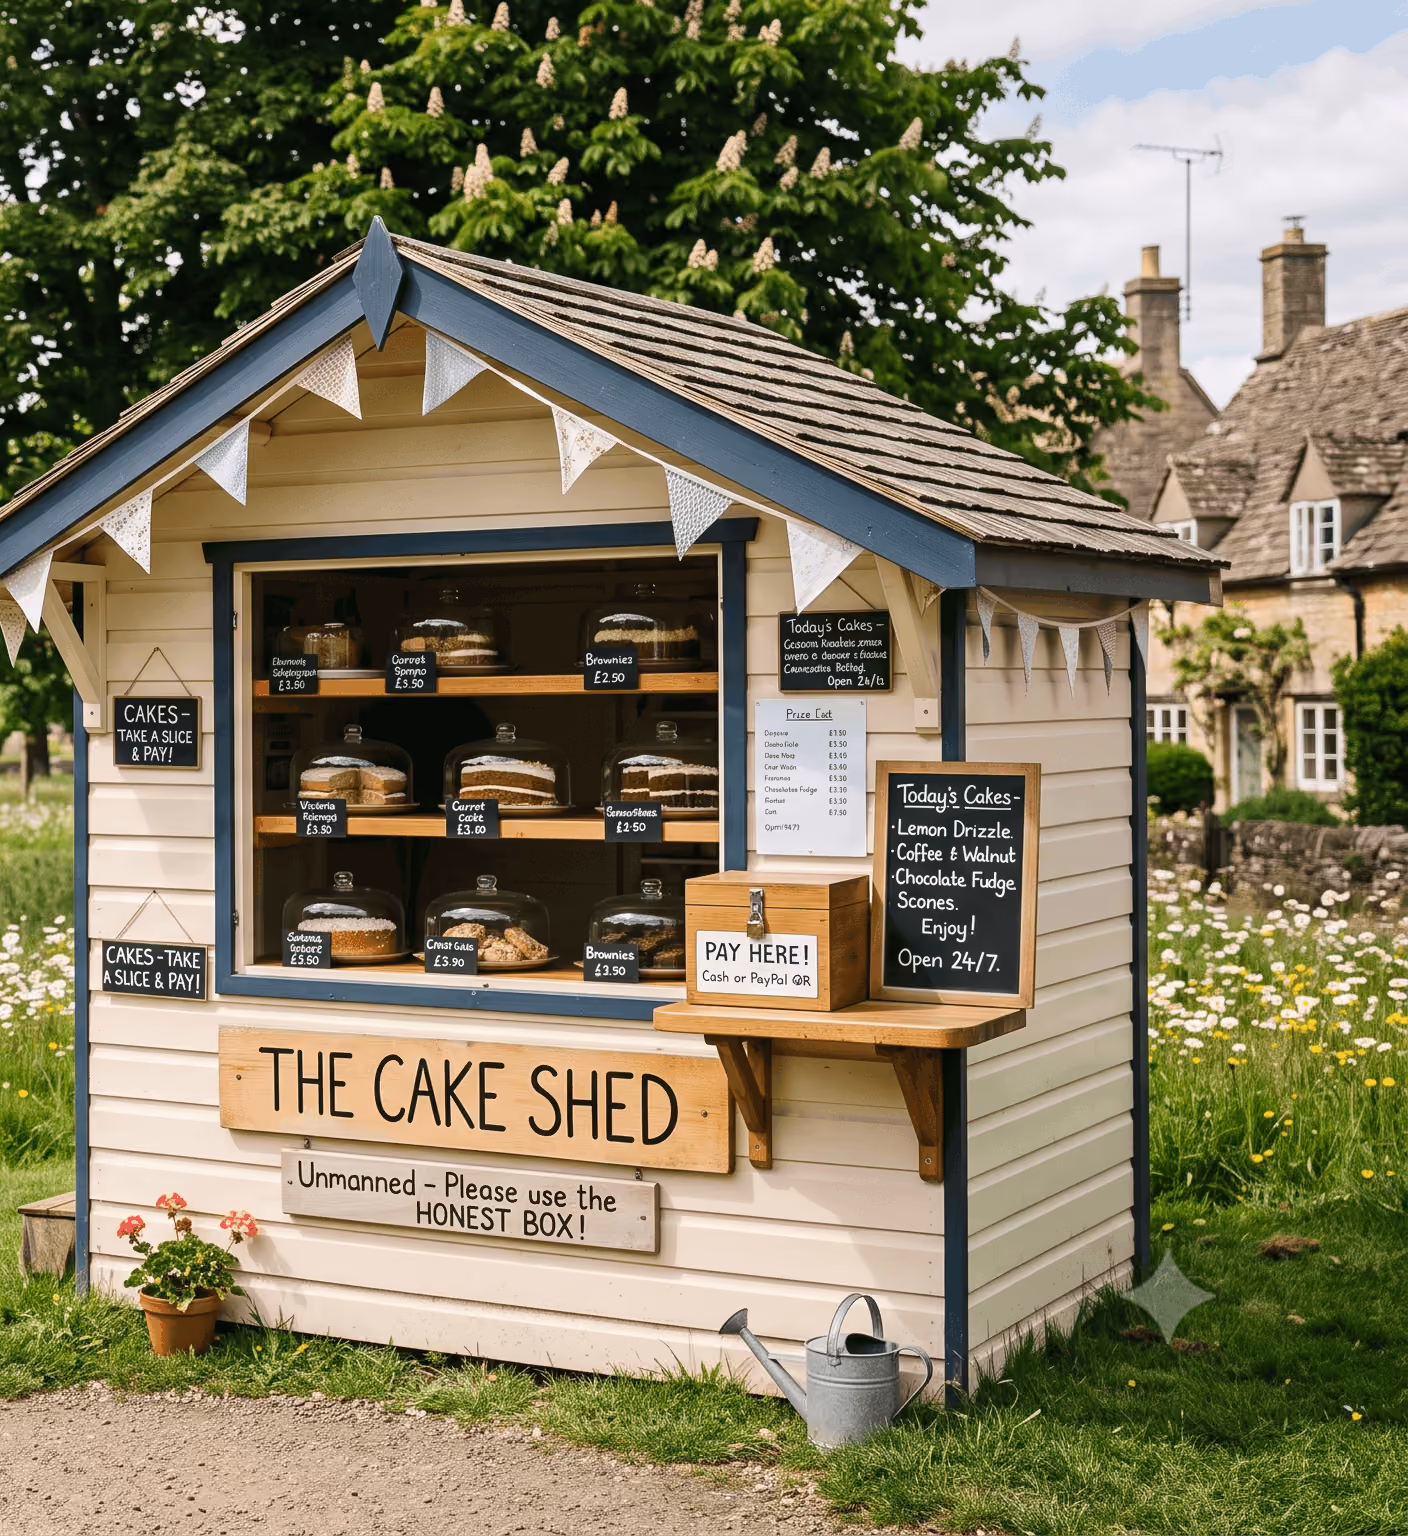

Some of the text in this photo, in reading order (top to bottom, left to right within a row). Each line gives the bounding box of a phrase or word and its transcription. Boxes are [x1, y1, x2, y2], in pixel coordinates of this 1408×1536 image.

[786, 618, 832, 638] Today's
[837, 618, 873, 632] Cakes
[593, 670, 626, 684] £2.50
[827, 675, 852, 689] Open
[124, 704, 178, 724] CAKES
[117, 729, 193, 744] TAKE A SLICE
[132, 746, 173, 763] & PAY!
[897, 783, 958, 814] Today's
[897, 818, 947, 837] Lemon
[896, 843, 943, 863] Coffee
[962, 845, 1016, 864] Walnut
[895, 868, 1017, 898] Chocolate Fudge
[897, 891, 959, 911] Scones.
[106, 945, 154, 966] CAKES
[164, 949, 200, 969] TAKE
[705, 941, 809, 966] PAY HERE!
[898, 948, 943, 973] Open
[103, 969, 200, 994] A SLICE & PAY!
[702, 969, 729, 982] Cash
[734, 974, 747, 983] or
[750, 971, 788, 988] PayPal
[259, 1046, 679, 1145] THE CAKE SHED
[297, 1160, 416, 1196] Unmanned
[444, 1171, 518, 1203] Please
[528, 1189, 567, 1208] use
[576, 1184, 617, 1213] the
[416, 1200, 586, 1241] HONEST BOX!
